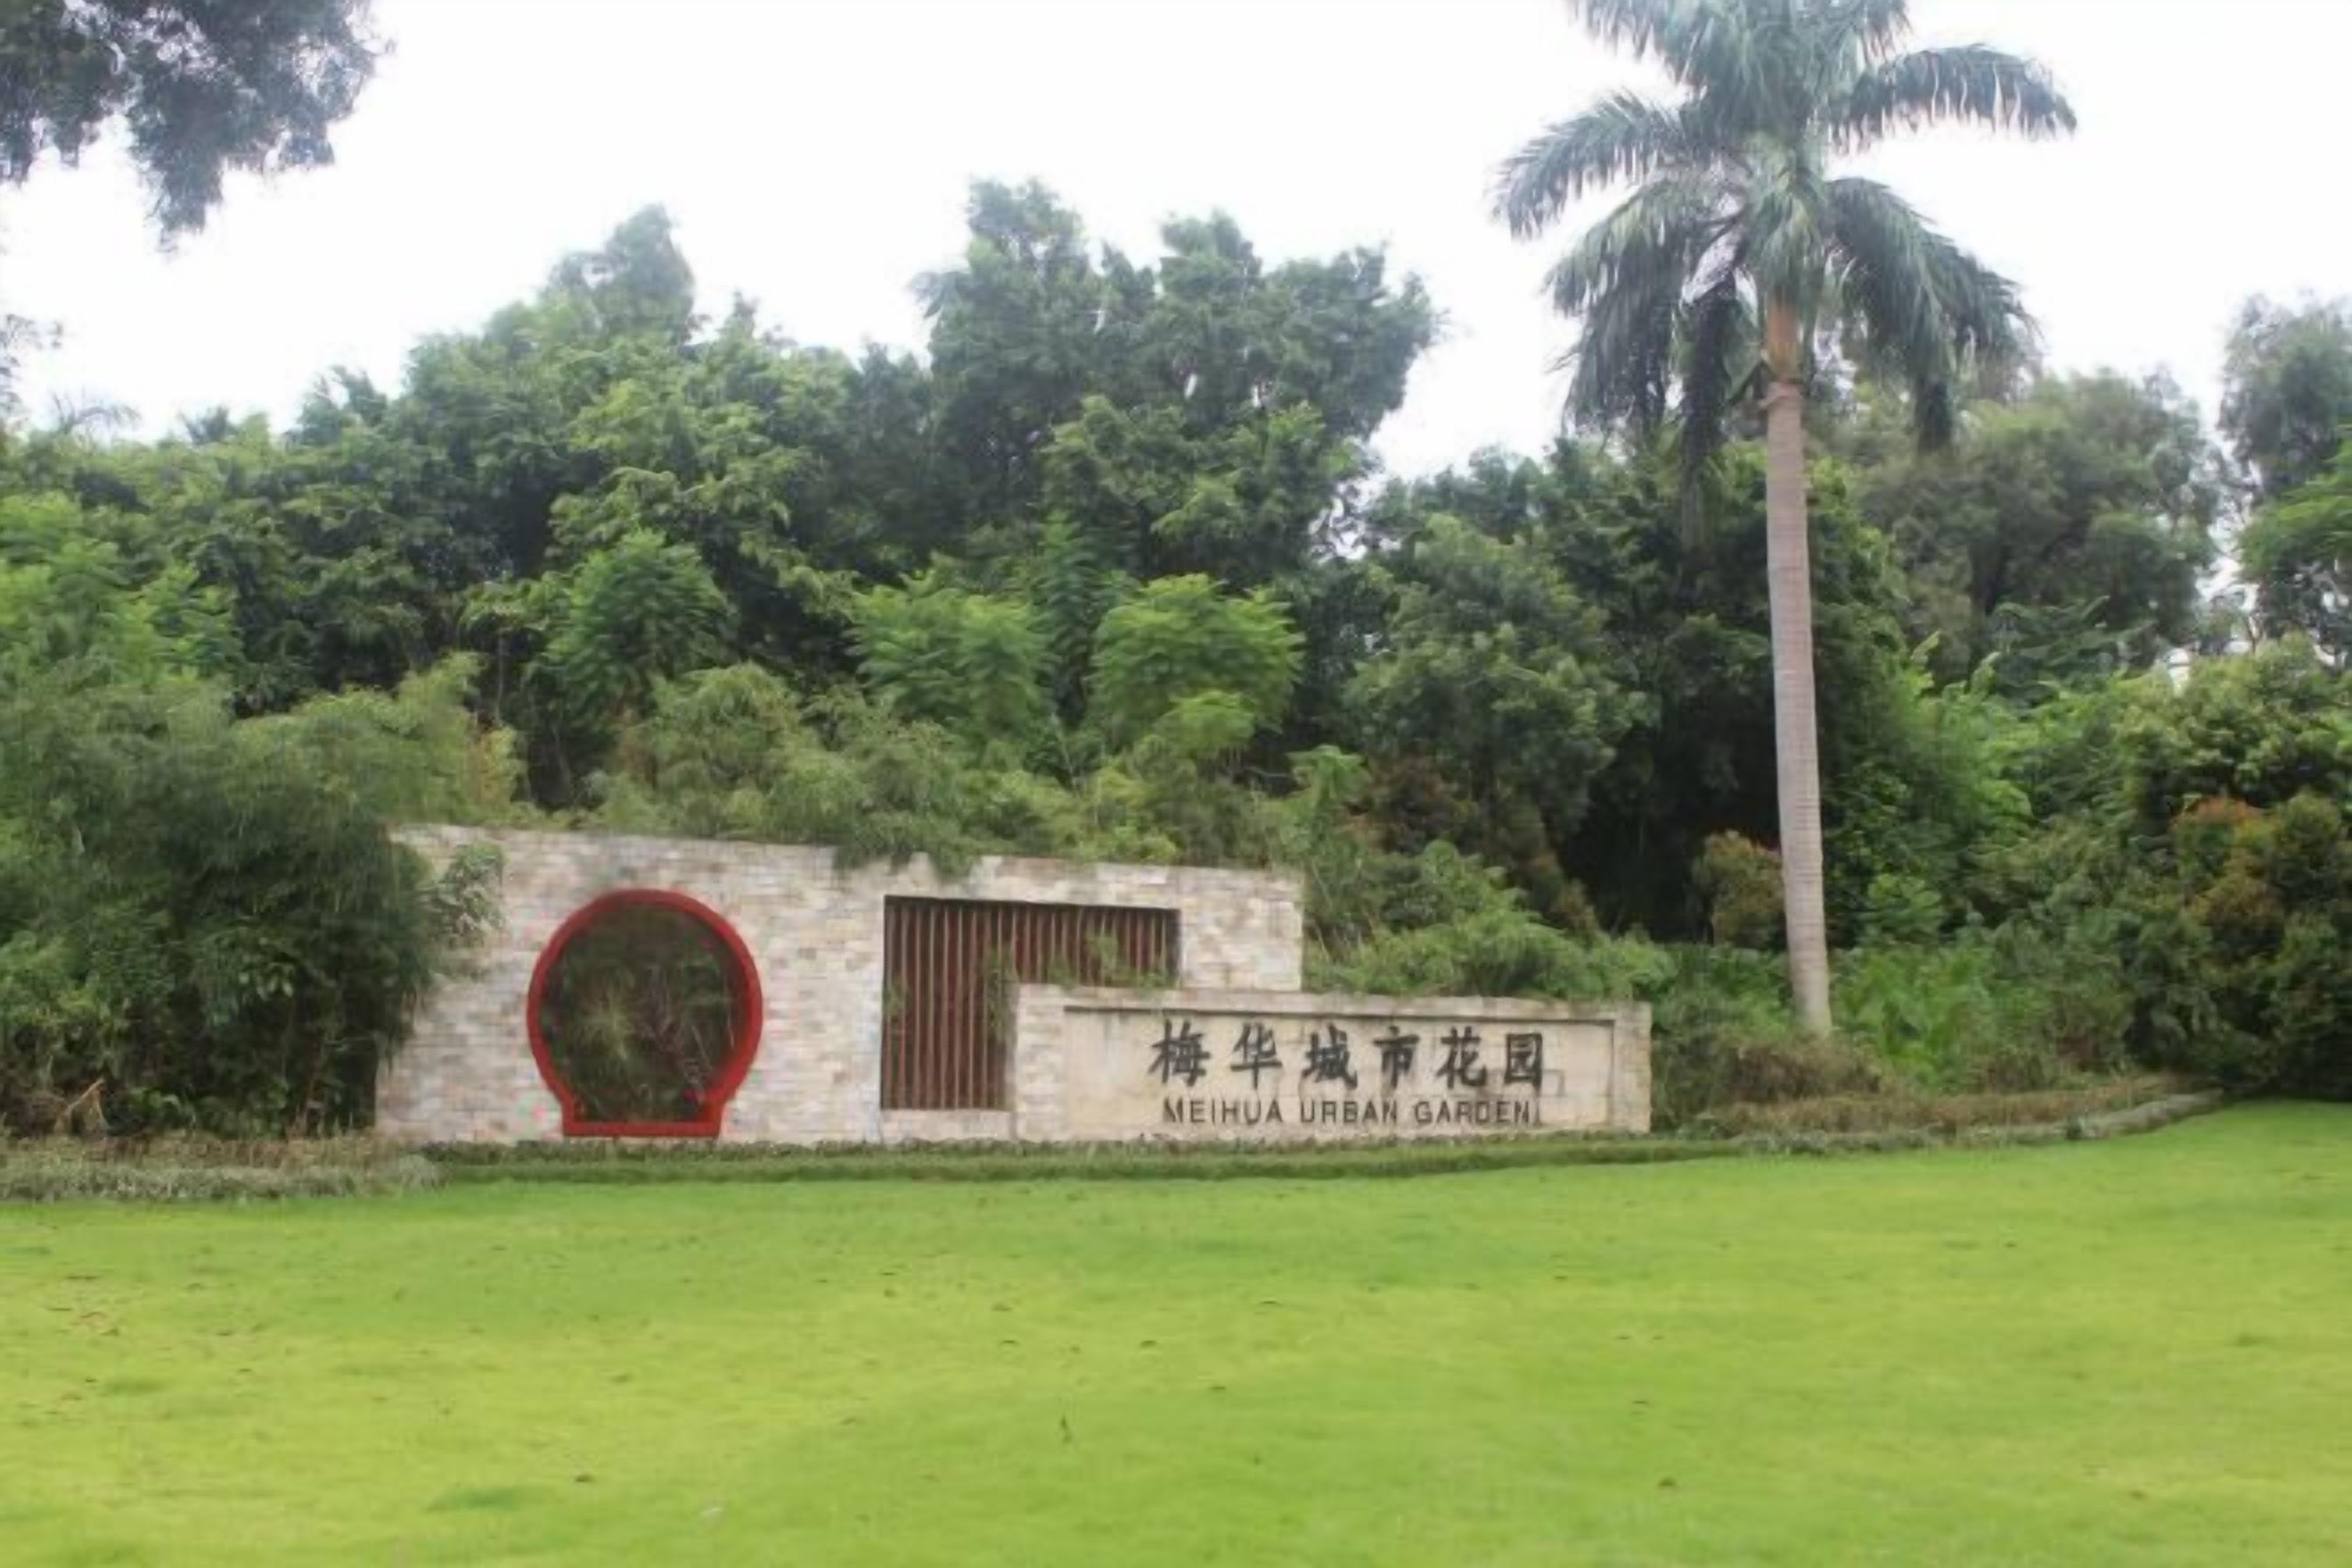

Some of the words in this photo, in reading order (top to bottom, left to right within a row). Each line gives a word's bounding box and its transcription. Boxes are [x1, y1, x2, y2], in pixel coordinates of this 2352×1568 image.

[1148, 1018, 1543, 1090] 梅华城市花园
[1164, 1097, 1283, 1124] MEIHUA
[1300, 1098, 1397, 1124] URBAN
[1415, 1099, 1531, 1124] GARDEN
